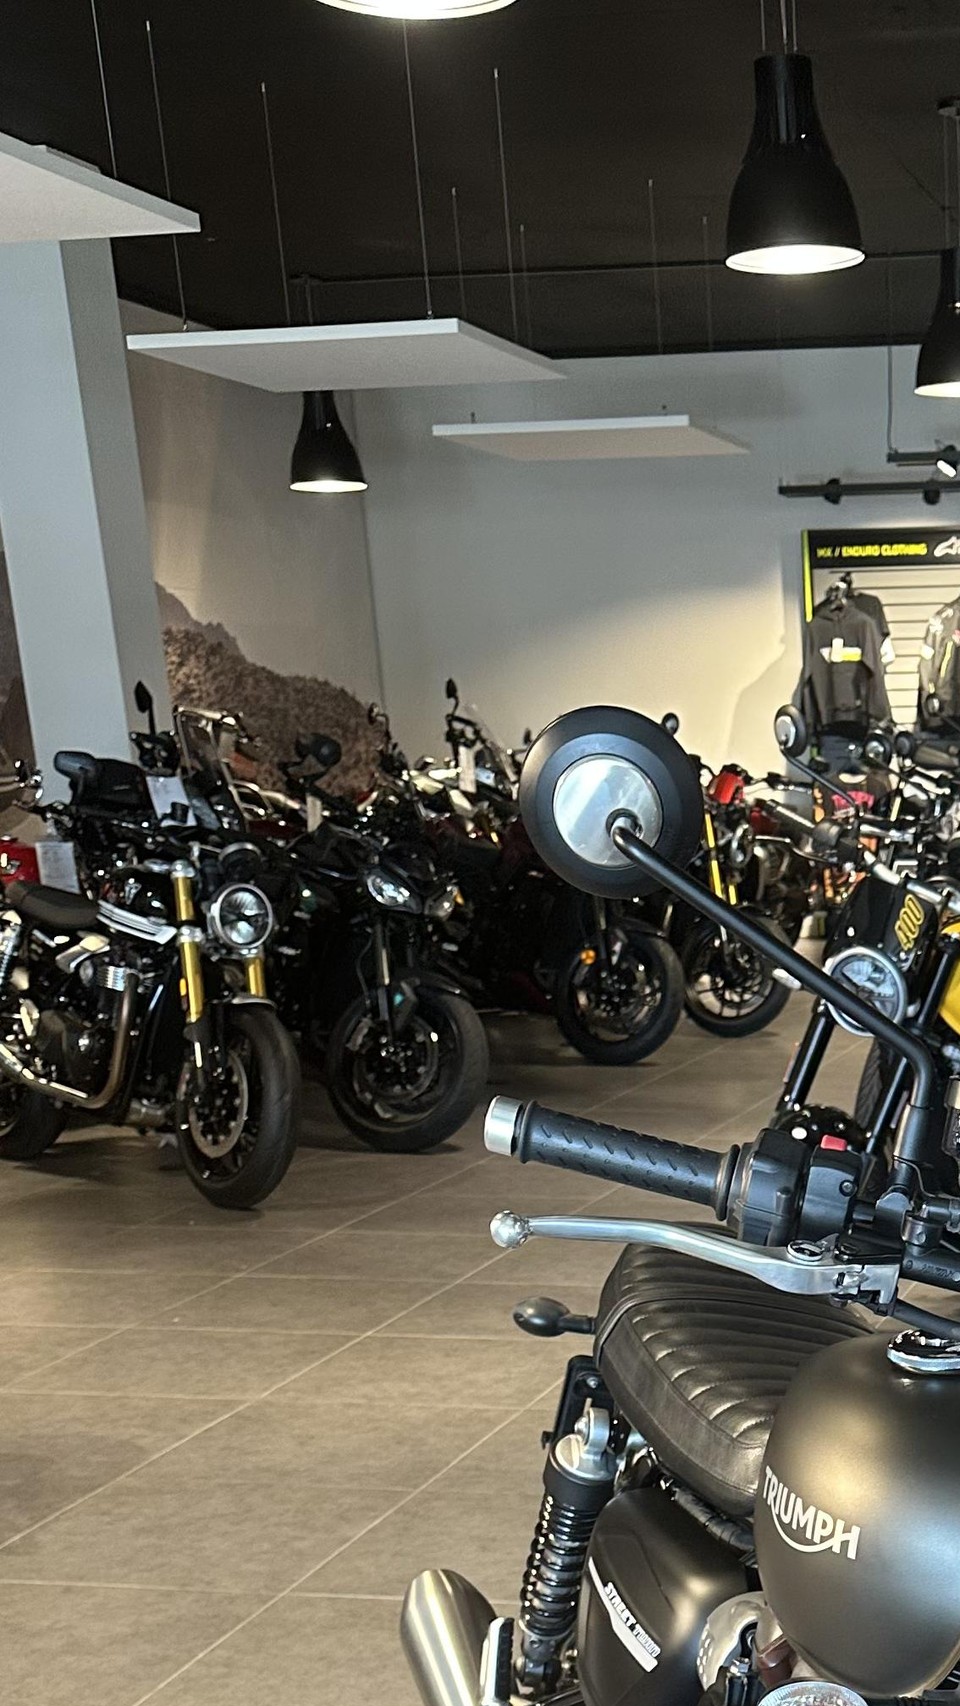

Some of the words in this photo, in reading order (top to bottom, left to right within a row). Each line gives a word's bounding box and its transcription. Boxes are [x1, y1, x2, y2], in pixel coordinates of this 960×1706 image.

[881, 542, 928, 556] CLOTHING
[894, 893, 925, 951] 400
[763, 1465, 861, 1560] TRIUMPH
[604, 1582, 637, 1627] STREET
